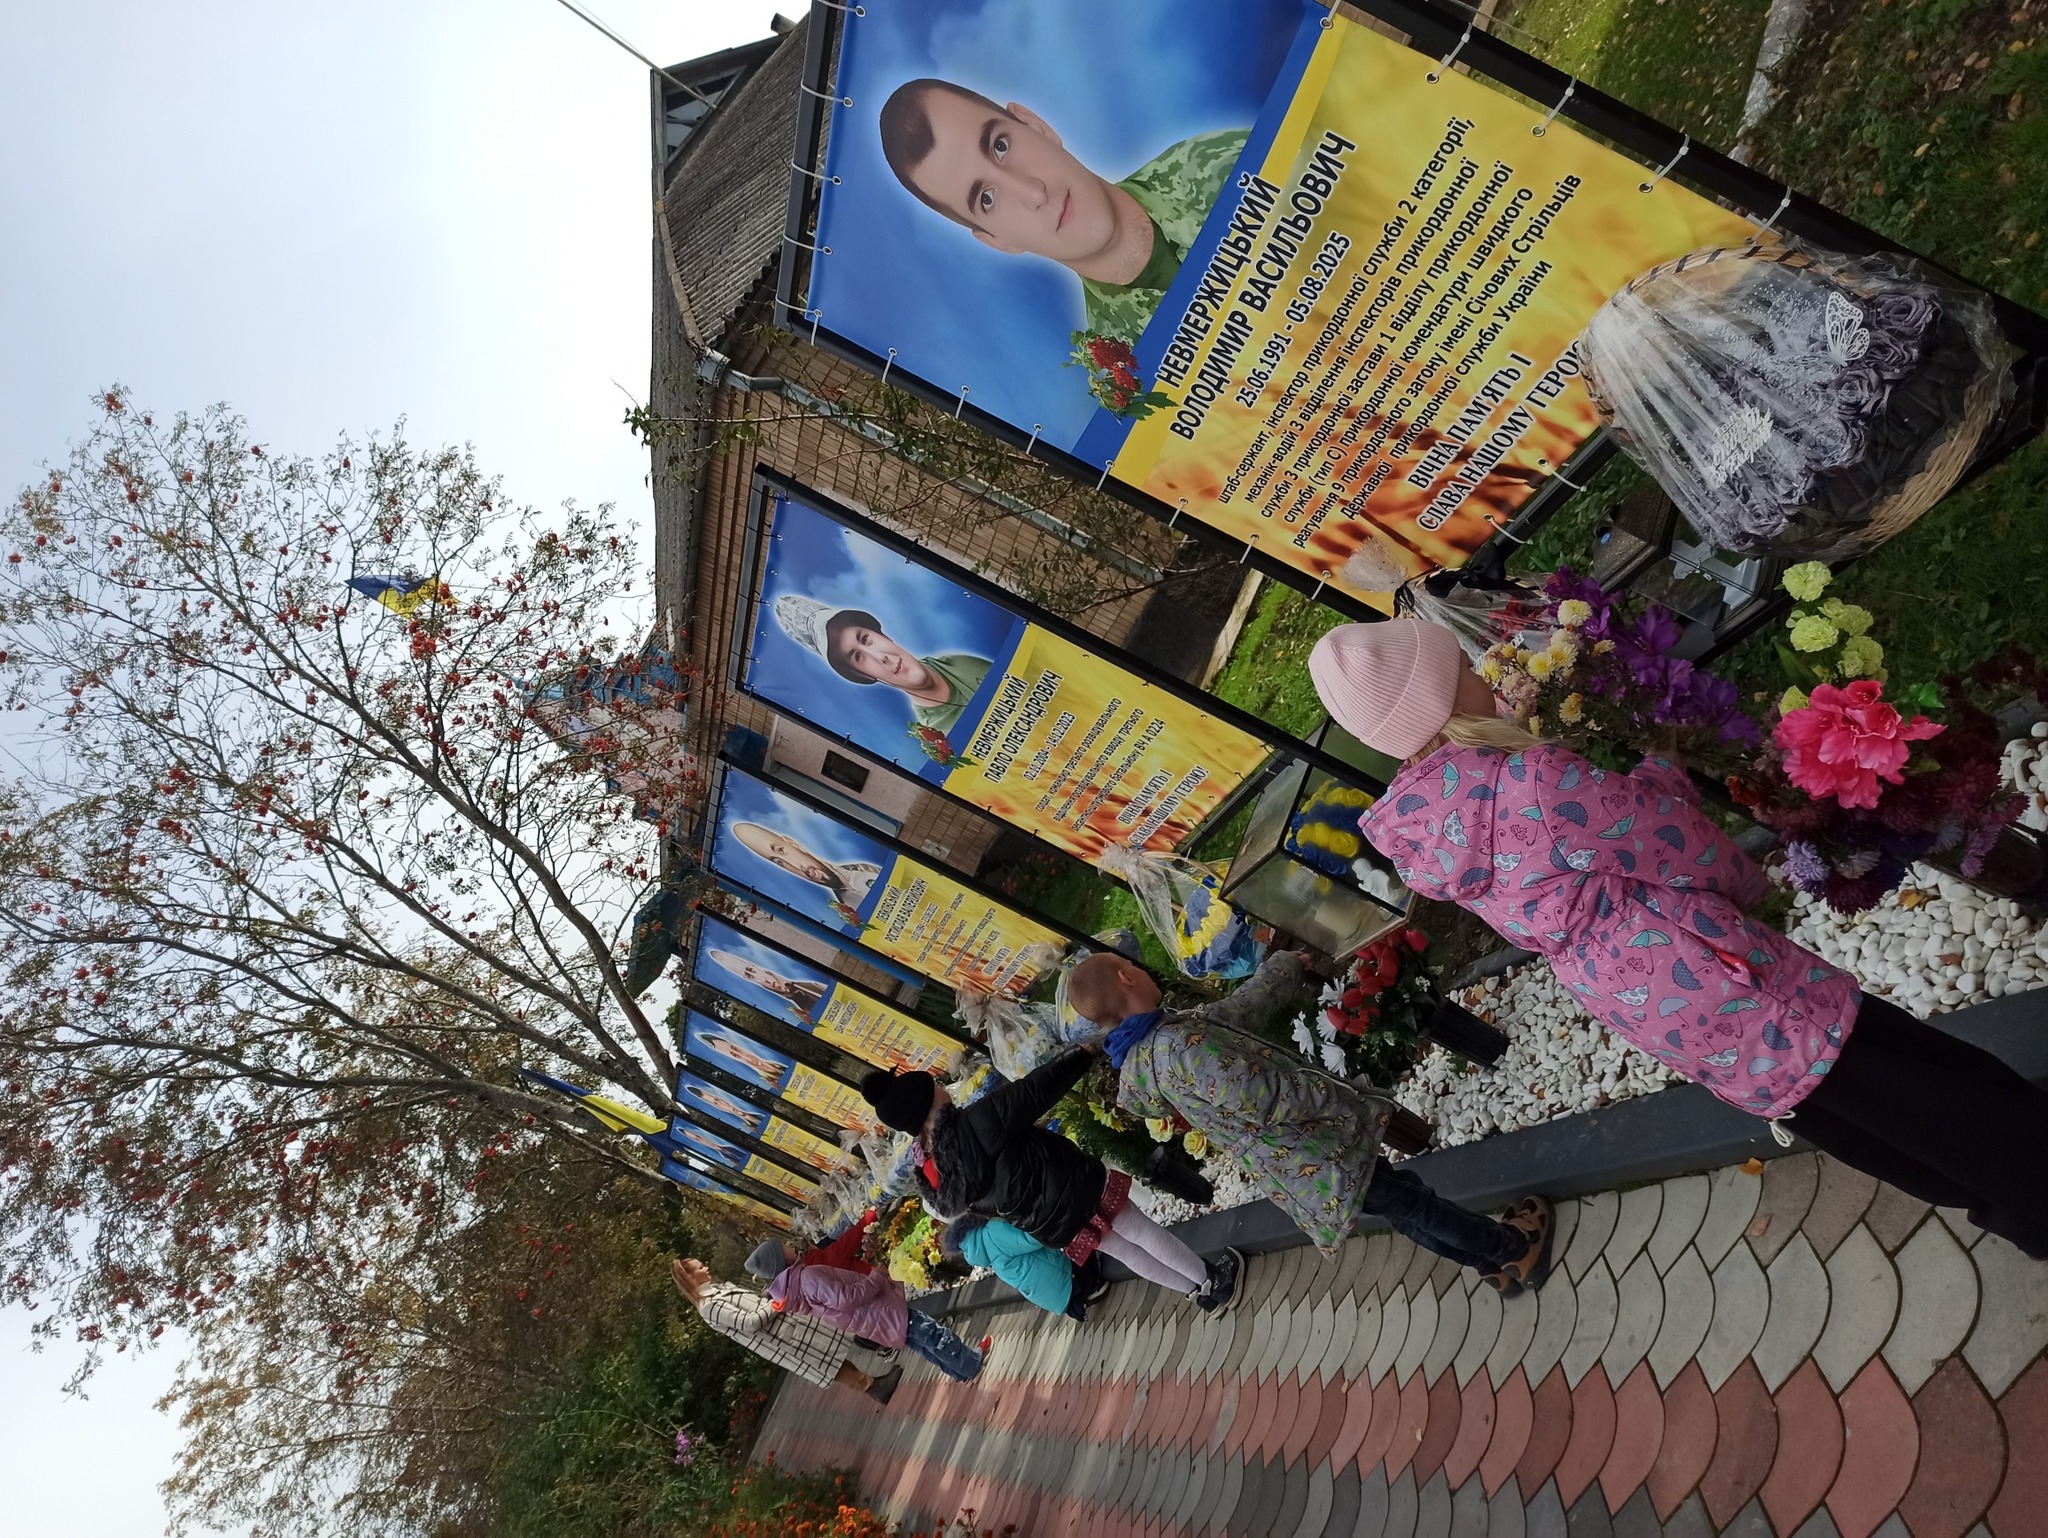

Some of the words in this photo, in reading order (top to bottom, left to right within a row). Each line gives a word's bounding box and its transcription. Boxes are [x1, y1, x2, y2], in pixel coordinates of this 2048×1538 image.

[1156, 173, 1280, 387] НЕВМЕРЖИЦЬКИЙ
[1169, 310, 1253, 439] ВОЛОДИМИР
[1237, 131, 1355, 312] ВАСИЛЬОВИЧ
[1218, 430, 1274, 503] штаб-сержант,
[1262, 371, 1310, 428] інспектор
[1302, 273, 1369, 371] прикордонної
[1362, 215, 1408, 275] служби
[1397, 200, 1417, 214] 2
[1410, 116, 1474, 200] категорії,
[1235, 332, 1291, 407] 25.06.1991
[1285, 231, 1349, 322] 05.08.2025
[1244, 429, 1298, 502] механік-водій
[1289, 420, 1304, 431] 3
[1337, 275, 1401, 355] інспекторів
[1395, 156, 1479, 275] прикордонної
[1260, 479, 1292, 517] служби
[1284, 470, 1298, 480] 3
[1292, 390, 1352, 471] прикордонної
[1346, 343, 1388, 394] застави
[1379, 331, 1396, 343] 1
[1389, 278, 1434, 331] відділу
[1425, 160, 1513, 279] прикордонної
[1283, 484, 1317, 522] служби
[1308, 460, 1334, 485] (тип
[1326, 446, 1347, 460] С)
[1338, 360, 1405, 446] прикордонної
[1399, 270, 1473, 363] комендатури
[1466, 188, 1532, 270] швидкого
[1292, 491, 1343, 548] реагування
[1331, 482, 1345, 492] 9
[1340, 397, 1411, 483] прикордонного
[1405, 351, 1447, 397] загону
[1435, 313, 1474, 352] імені
[1465, 254, 1520, 314] Січових
[1511, 174, 1580, 253] Стрільців
[1340, 458, 1392, 520] Державної
[1389, 372, 1460, 459] прикордонної
[1455, 321, 1503, 375] служби
[1492, 260, 1552, 321] України
[1407, 442, 1459, 488] ВІЧНА
[1446, 367, 1520, 442] ПАМ'ЯТЬ
[1509, 353, 1531, 365] І
[1419, 478, 1471, 529] СЛАВА
[1458, 405, 1532, 482] НАШОМУ
[970, 673, 1028, 760] НЕВМЕРЖИЦЬКИЙ
[983, 751, 1012, 783] ПАВЛО
[1001, 669, 1062, 754] ОЛЕКСАНДРОВИЧ
[1023, 748, 1050, 780] 02.11.2004
[1045, 711, 1075, 747] 14.12.2023
[1117, 801, 1143, 824] ВІЧНА
[1134, 775, 1168, 805] ПАМ'ЯТЬ
[1129, 821, 1155, 846] СЛАВА
[1146, 795, 1178, 826] НАШОМУ
[1173, 765, 1208, 796] ГЕРОЮ!
[882, 912, 908, 943] РОСТИСЛАВ
[896, 876, 928, 917] ВАЛЕРІЙОВИЧ
